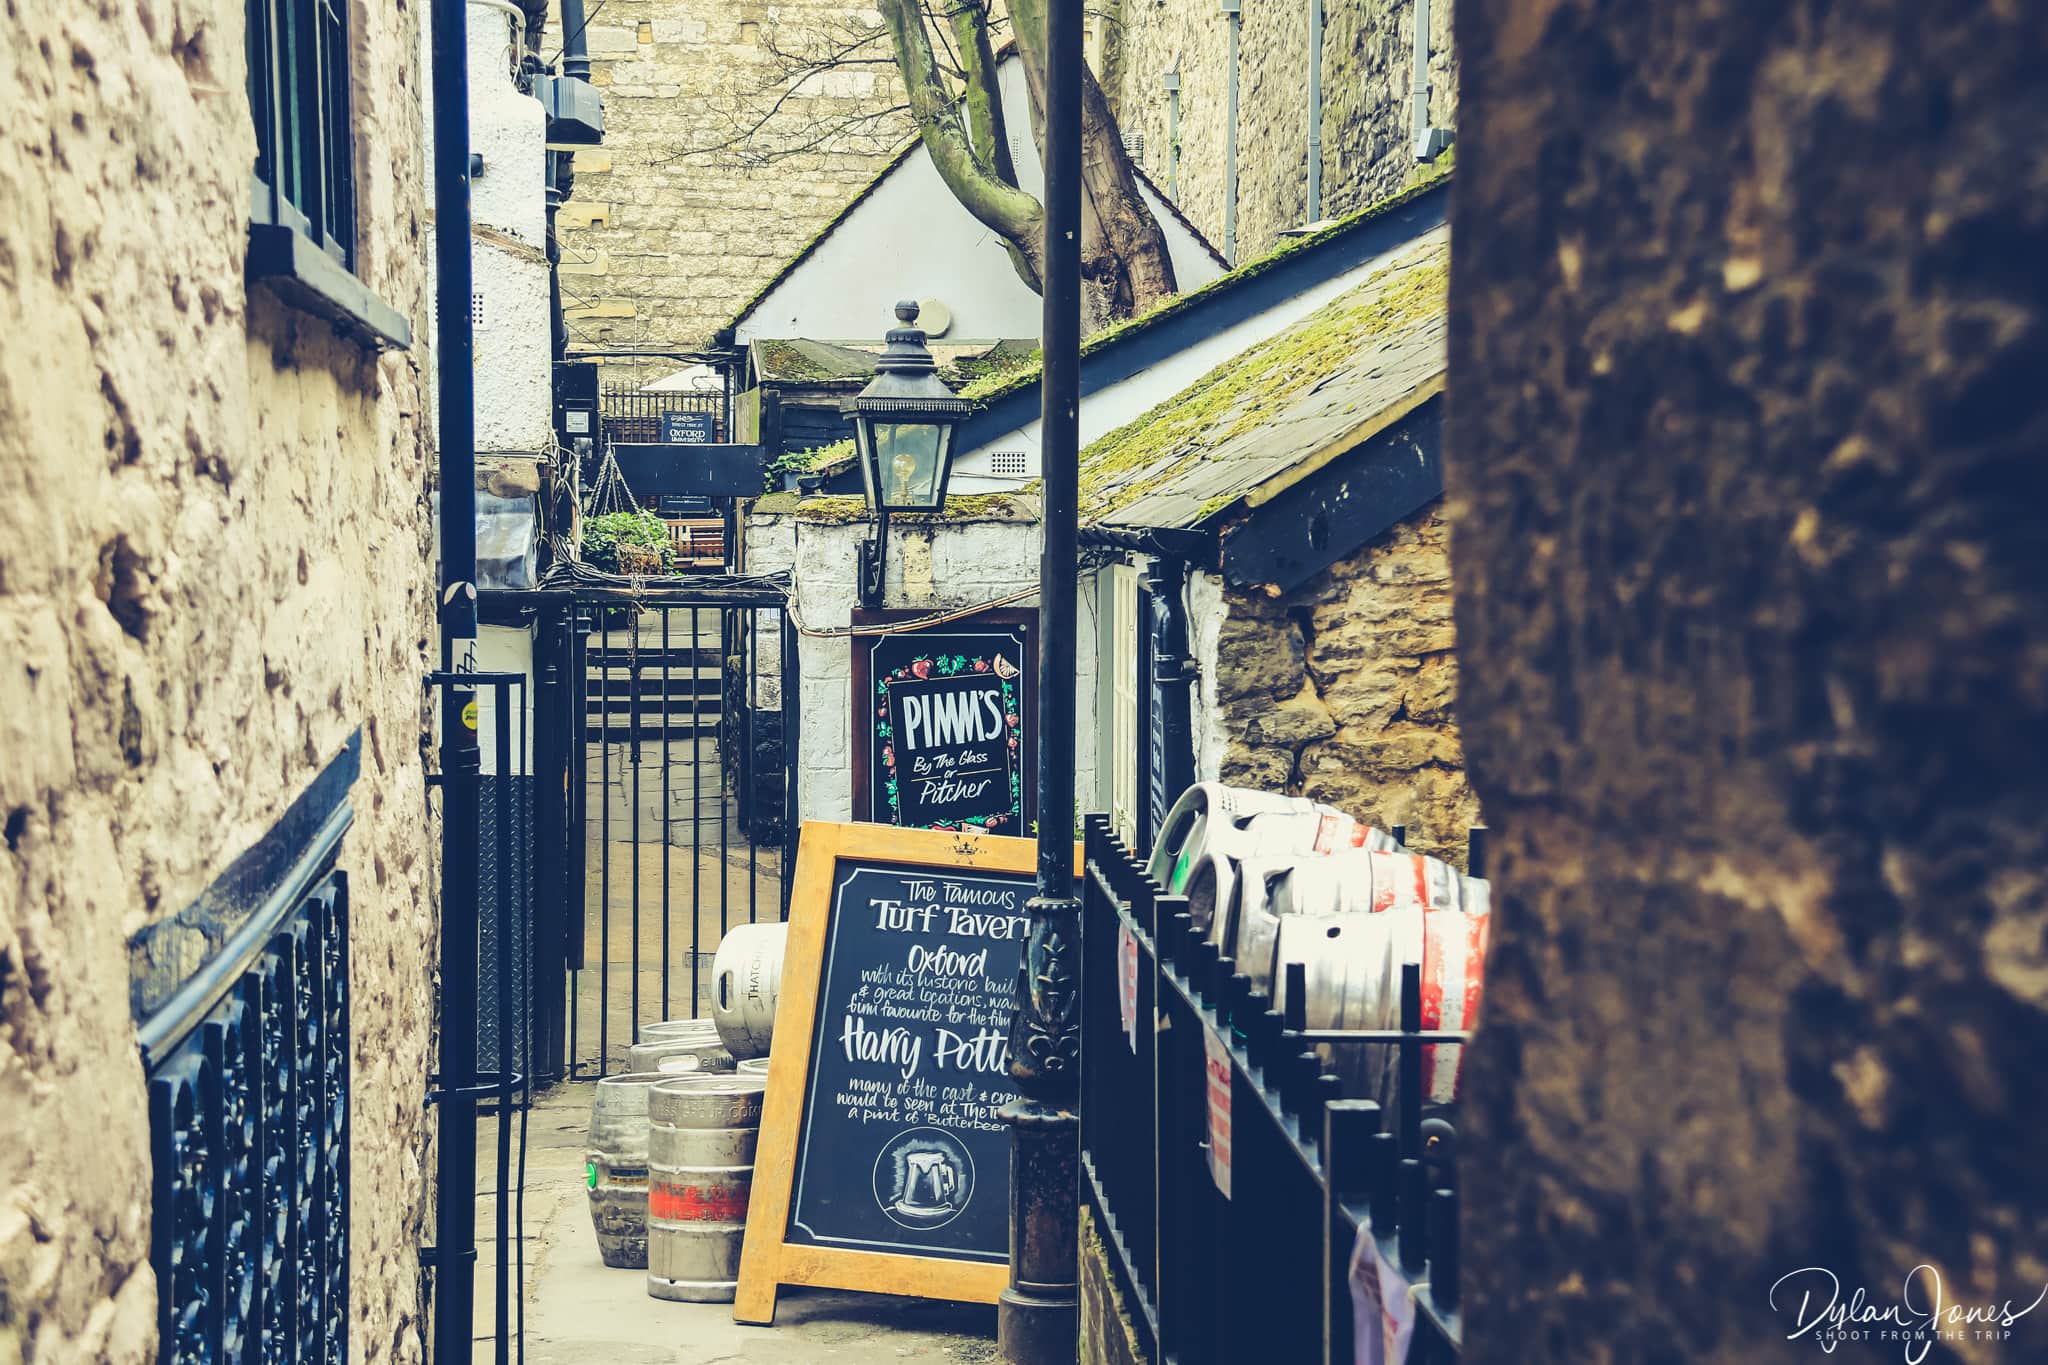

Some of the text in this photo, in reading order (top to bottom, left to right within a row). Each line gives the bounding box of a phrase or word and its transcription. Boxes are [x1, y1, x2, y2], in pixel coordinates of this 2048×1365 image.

[669, 428, 706, 438] OXFORD
[902, 689, 1003, 751] PIMM'S
[913, 749, 989, 776] By The Glass
[943, 769, 958, 779] or
[919, 778, 992, 805] Pitcher
[900, 880, 1016, 910] The Famous
[869, 898, 941, 933] Turf
[908, 944, 988, 977] Oxford
[861, 962, 1017, 994] with its historic buil
[873, 986, 915, 1004] great
[989, 997, 1015, 1010] wa
[881, 1000, 943, 1022] favourite
[945, 1005, 967, 1025] for
[967, 1008, 987, 1025] the
[838, 1014, 922, 1079] Harry
[849, 1078, 892, 1096] many
[897, 1080, 911, 1095] of
[913, 1076, 938, 1099] the
[942, 1081, 978, 1102] cast
[836, 1092, 879, 1107] would
[904, 1096, 934, 1113] seen
[940, 1100, 957, 1115] at
[960, 1102, 988, 1119] The
[847, 1107, 859, 1119] a
[863, 1108, 900, 1125] pint
[905, 1111, 920, 1124] of
